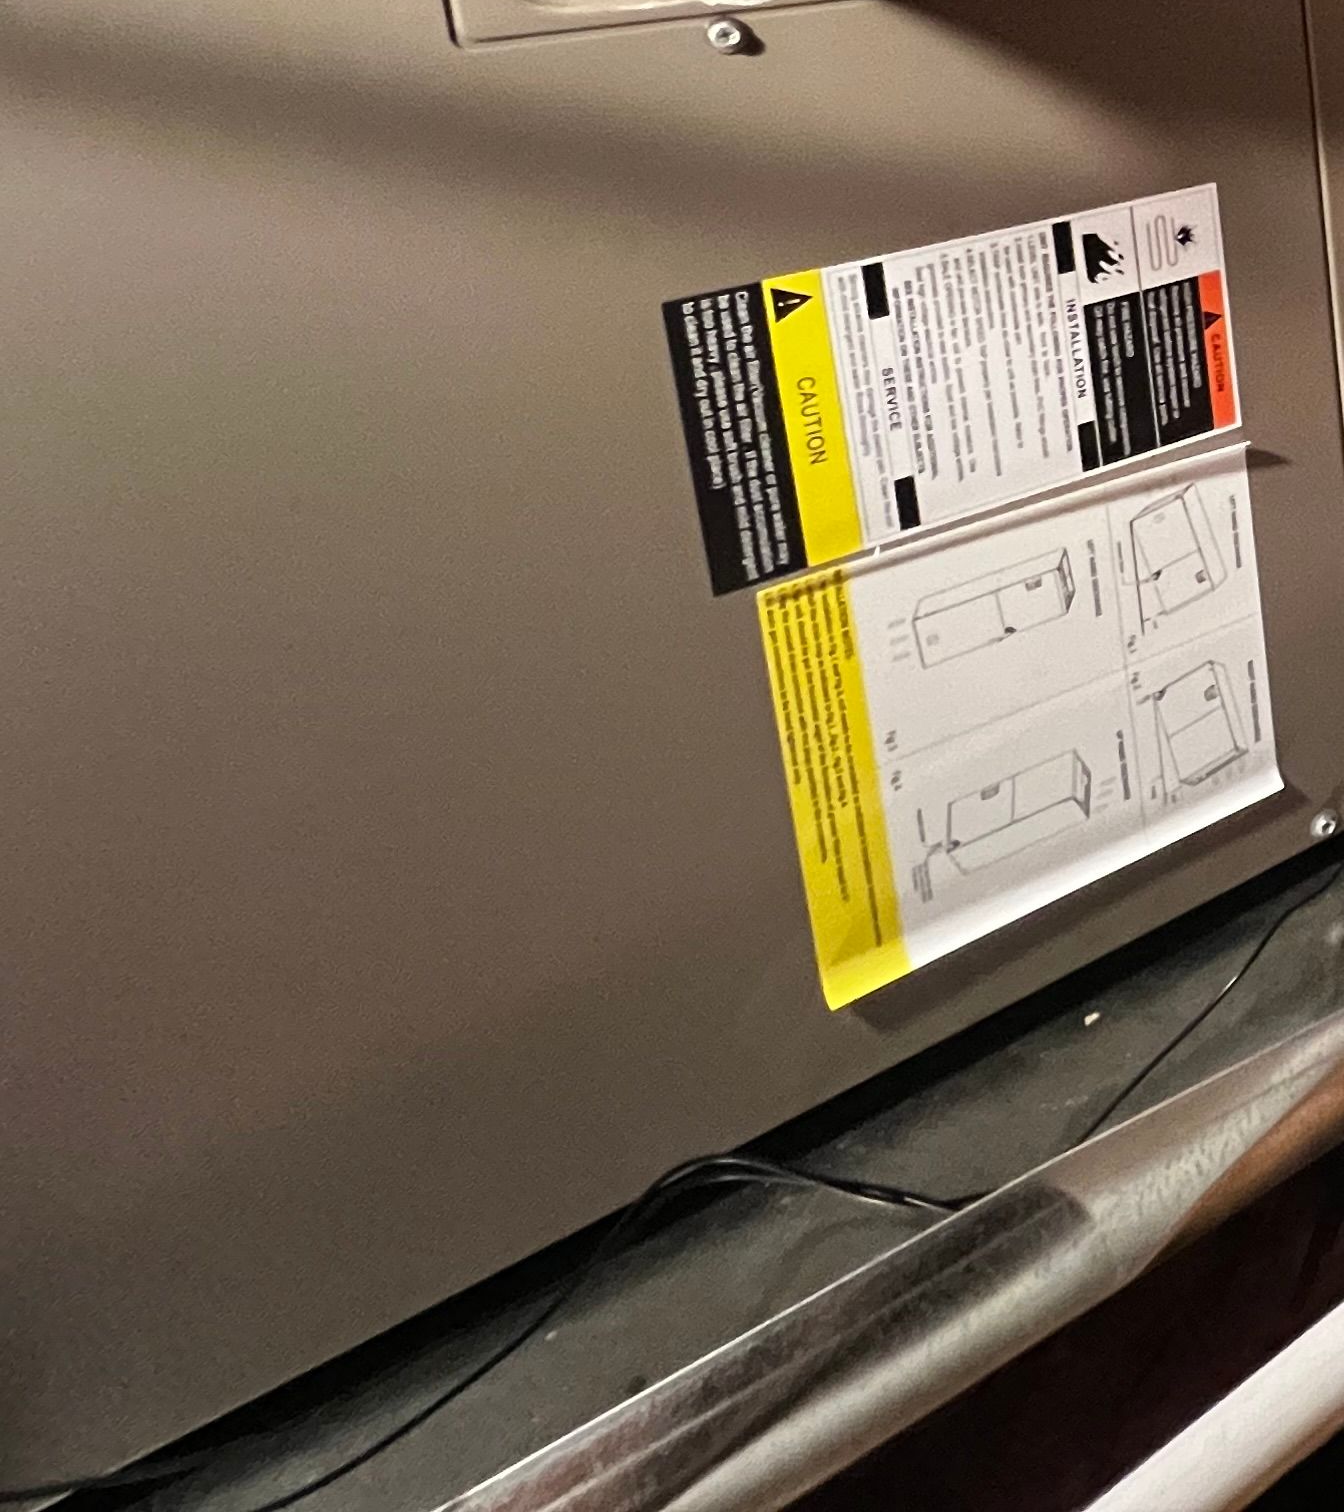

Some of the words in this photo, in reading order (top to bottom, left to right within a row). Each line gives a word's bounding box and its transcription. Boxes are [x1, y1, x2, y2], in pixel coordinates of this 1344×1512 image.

[734, 290, 752, 324] Clean
[739, 324, 755, 343] the
[1065, 298, 1087, 398] INSTALLATION
[796, 374, 828, 466] CAUTION
[881, 366, 901, 431] SERVICE
